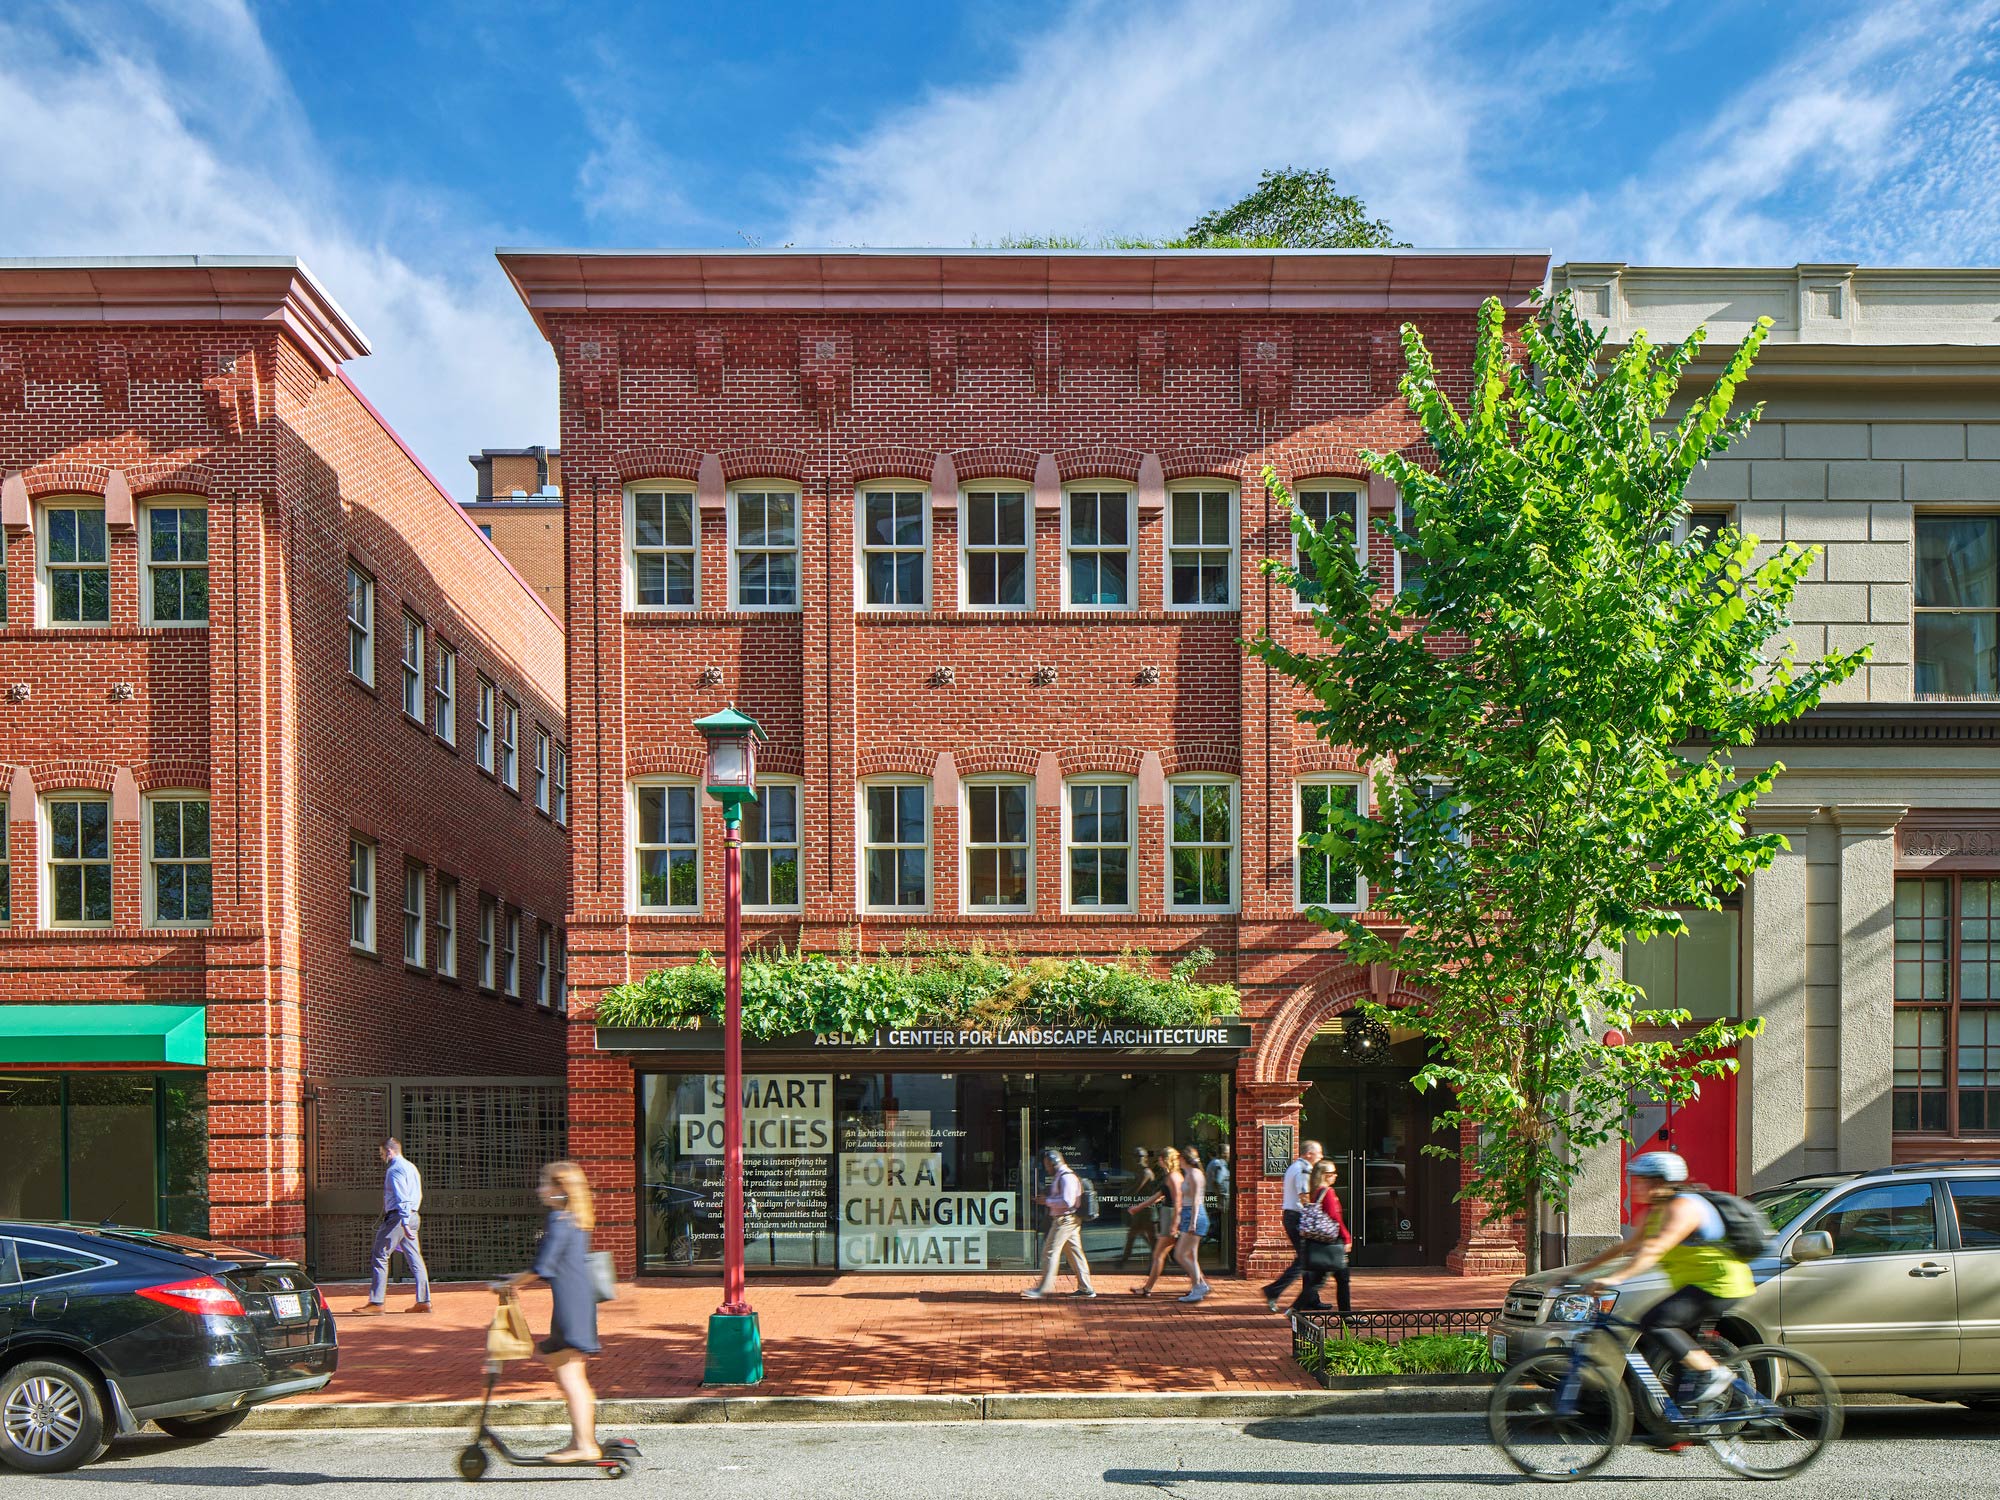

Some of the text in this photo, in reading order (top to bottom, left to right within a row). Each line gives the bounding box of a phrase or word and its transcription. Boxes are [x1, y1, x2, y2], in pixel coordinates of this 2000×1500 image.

[814, 1028, 1229, 1045] ASLA CENTER FOR LANDSCAPE ARCHITECTURE
[687, 1119, 828, 1149] POICIES
[919, 1129, 941, 1137] ASLA
[942, 1129, 967, 1137] Center
[845, 1139, 943, 1149] for Landscape Architecture
[763, 1158, 769, 1166] is
[770, 1158, 814, 1168] intensifying
[815, 1158, 828, 1166] the
[755, 1168, 783, 1179] impacts
[784, 1168, 793, 1179] of
[794, 1168, 828, 1176] standard
[845, 1158, 936, 1187] FOR A
[750, 1179, 782, 1189] practices
[783, 1179, 799, 1187] and
[799, 1179, 828, 1189] putting
[753, 1189, 800, 1197] communities
[810, 1189, 828, 1197] risk.
[693, 1200, 704, 1208] We
[706, 1200, 723, 1208] need
[784, 1200, 795, 1210] for
[796, 1200, 828, 1210] building
[707, 1210, 723, 1218] and
[763, 1210, 810, 1220] communities
[844, 1197, 1010, 1226] CHANGING
[750, 1220, 780, 1229] tandem
[780, 1220, 798, 1229] with
[798, 1220, 828, 1229] natural
[690, 1231, 719, 1241] systems
[845, 1236, 981, 1265] CLIMATE
